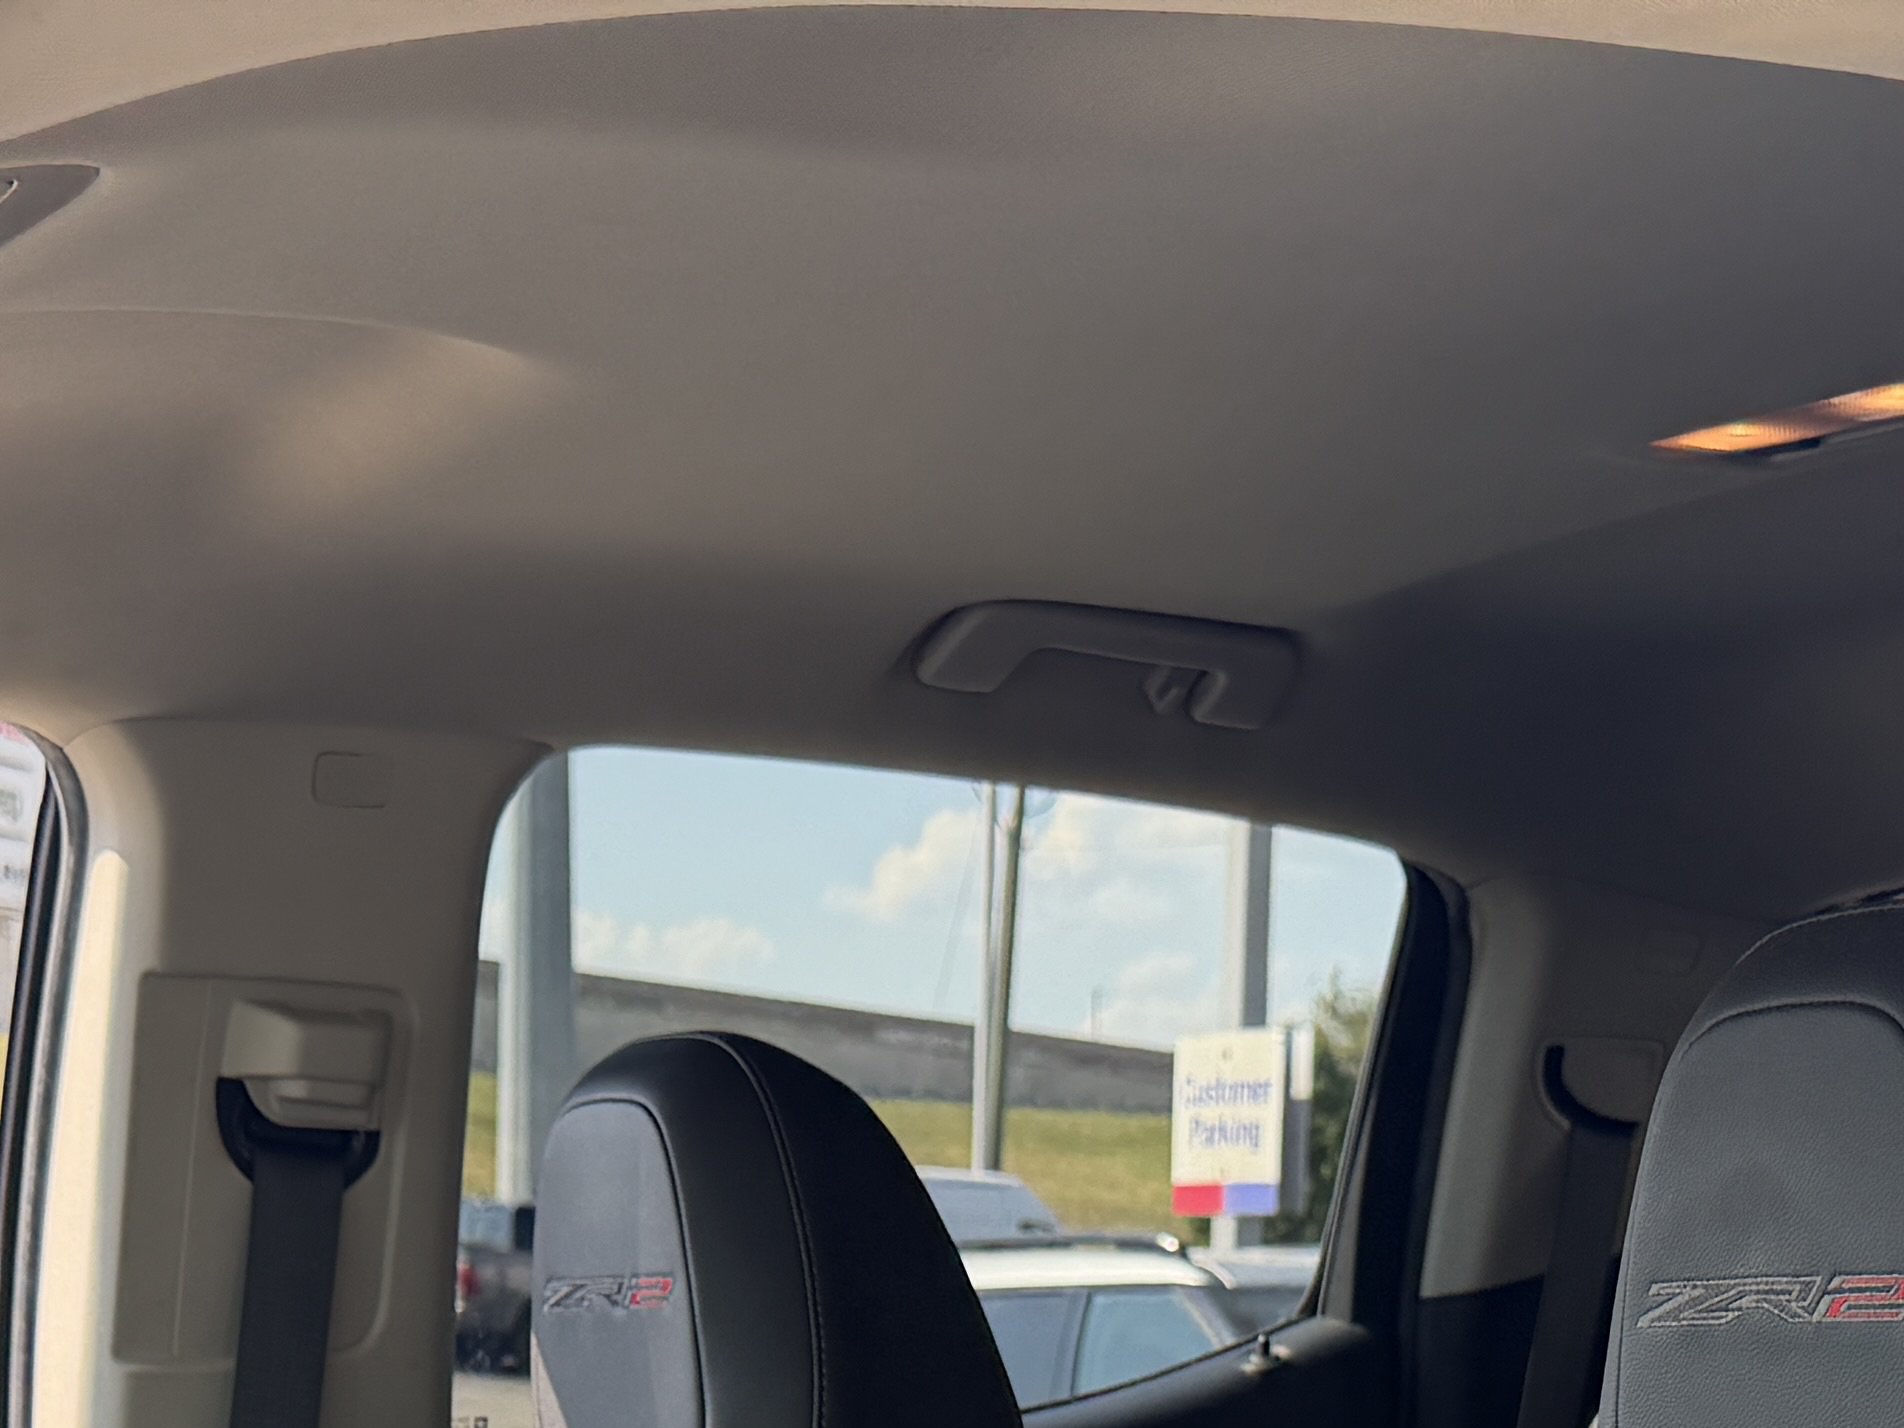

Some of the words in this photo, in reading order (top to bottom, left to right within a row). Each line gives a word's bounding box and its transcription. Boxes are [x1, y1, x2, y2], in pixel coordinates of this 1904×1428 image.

[1184, 1074, 1272, 1109] Customer
[1188, 1115, 1261, 1153] Parking
[543, 1271, 675, 1315] ZR2
